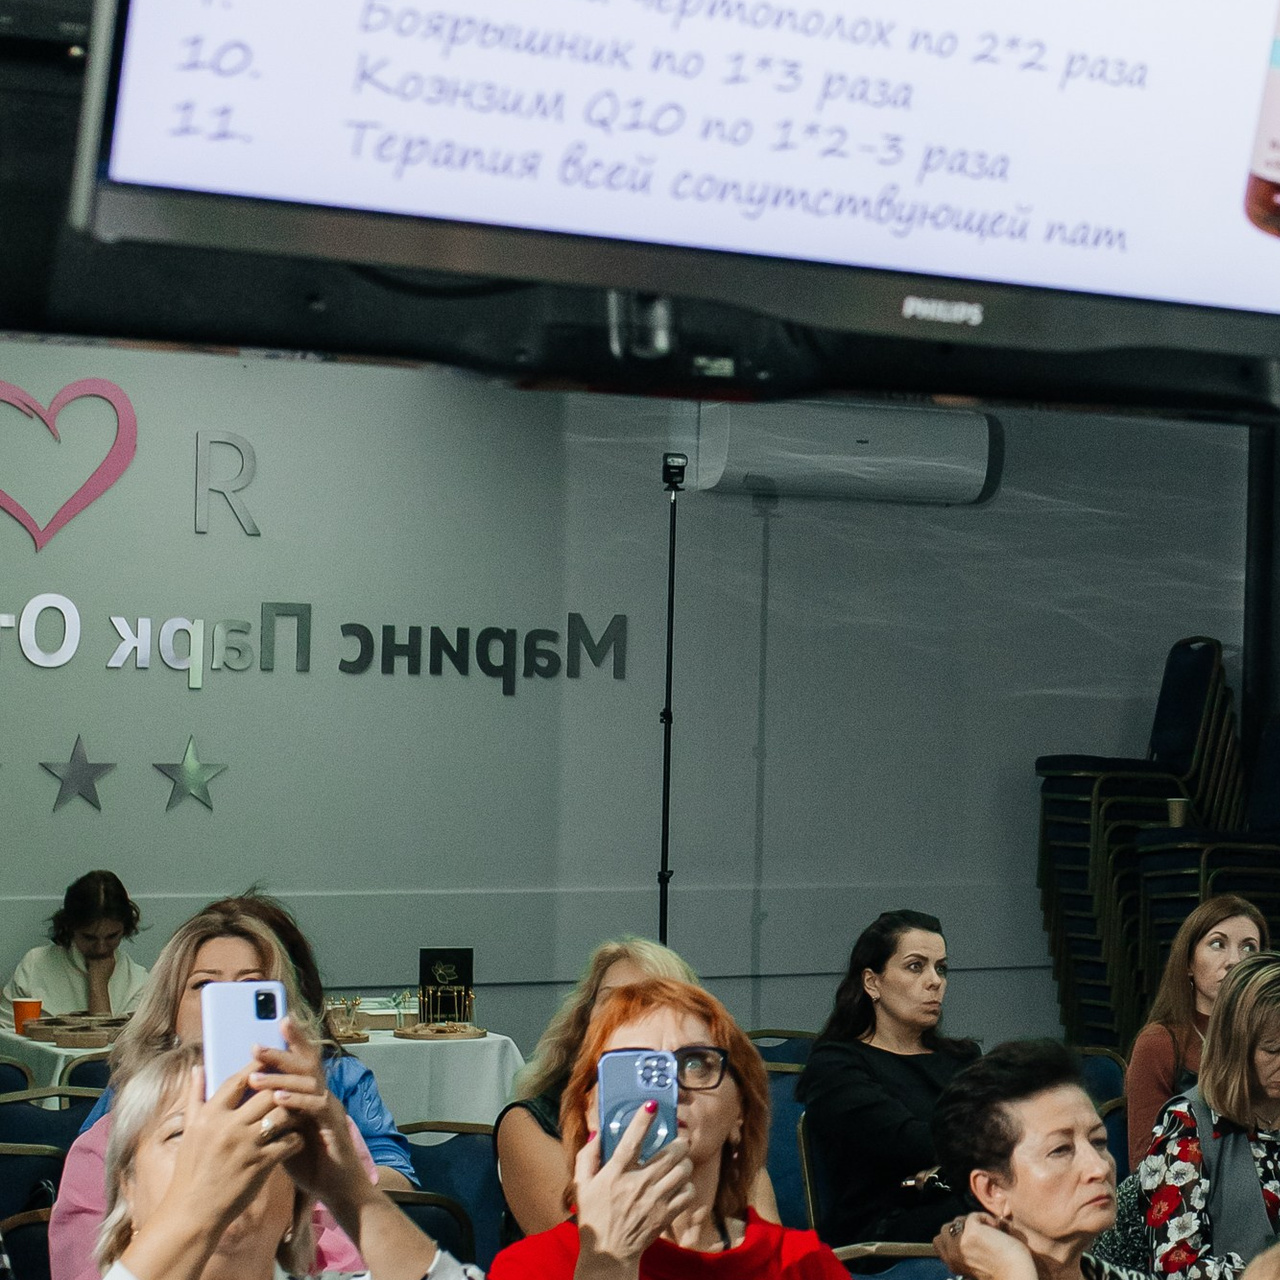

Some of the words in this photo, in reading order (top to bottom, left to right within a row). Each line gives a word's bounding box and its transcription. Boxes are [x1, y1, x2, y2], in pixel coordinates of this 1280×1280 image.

[651, 50, 706, 80] по
[816, 69, 915, 110] раза
[906, 27, 959, 60] по
[1058, 47, 1149, 91] раза
[175, 33, 263, 80] 10.
[351, 51, 567, 123] Коэнзим
[582, 88, 687, 138] Q10
[699, 116, 755, 148] по
[915, 142, 1012, 185] раза
[168, 99, 253, 145] 11.
[344, 118, 543, 181] Терапия
[557, 142, 658, 195] всей
[668, 167, 1034, 244] сопутствующей
[1043, 219, 1129, 253] пат
[902, 295, 985, 326] PHILIPS
